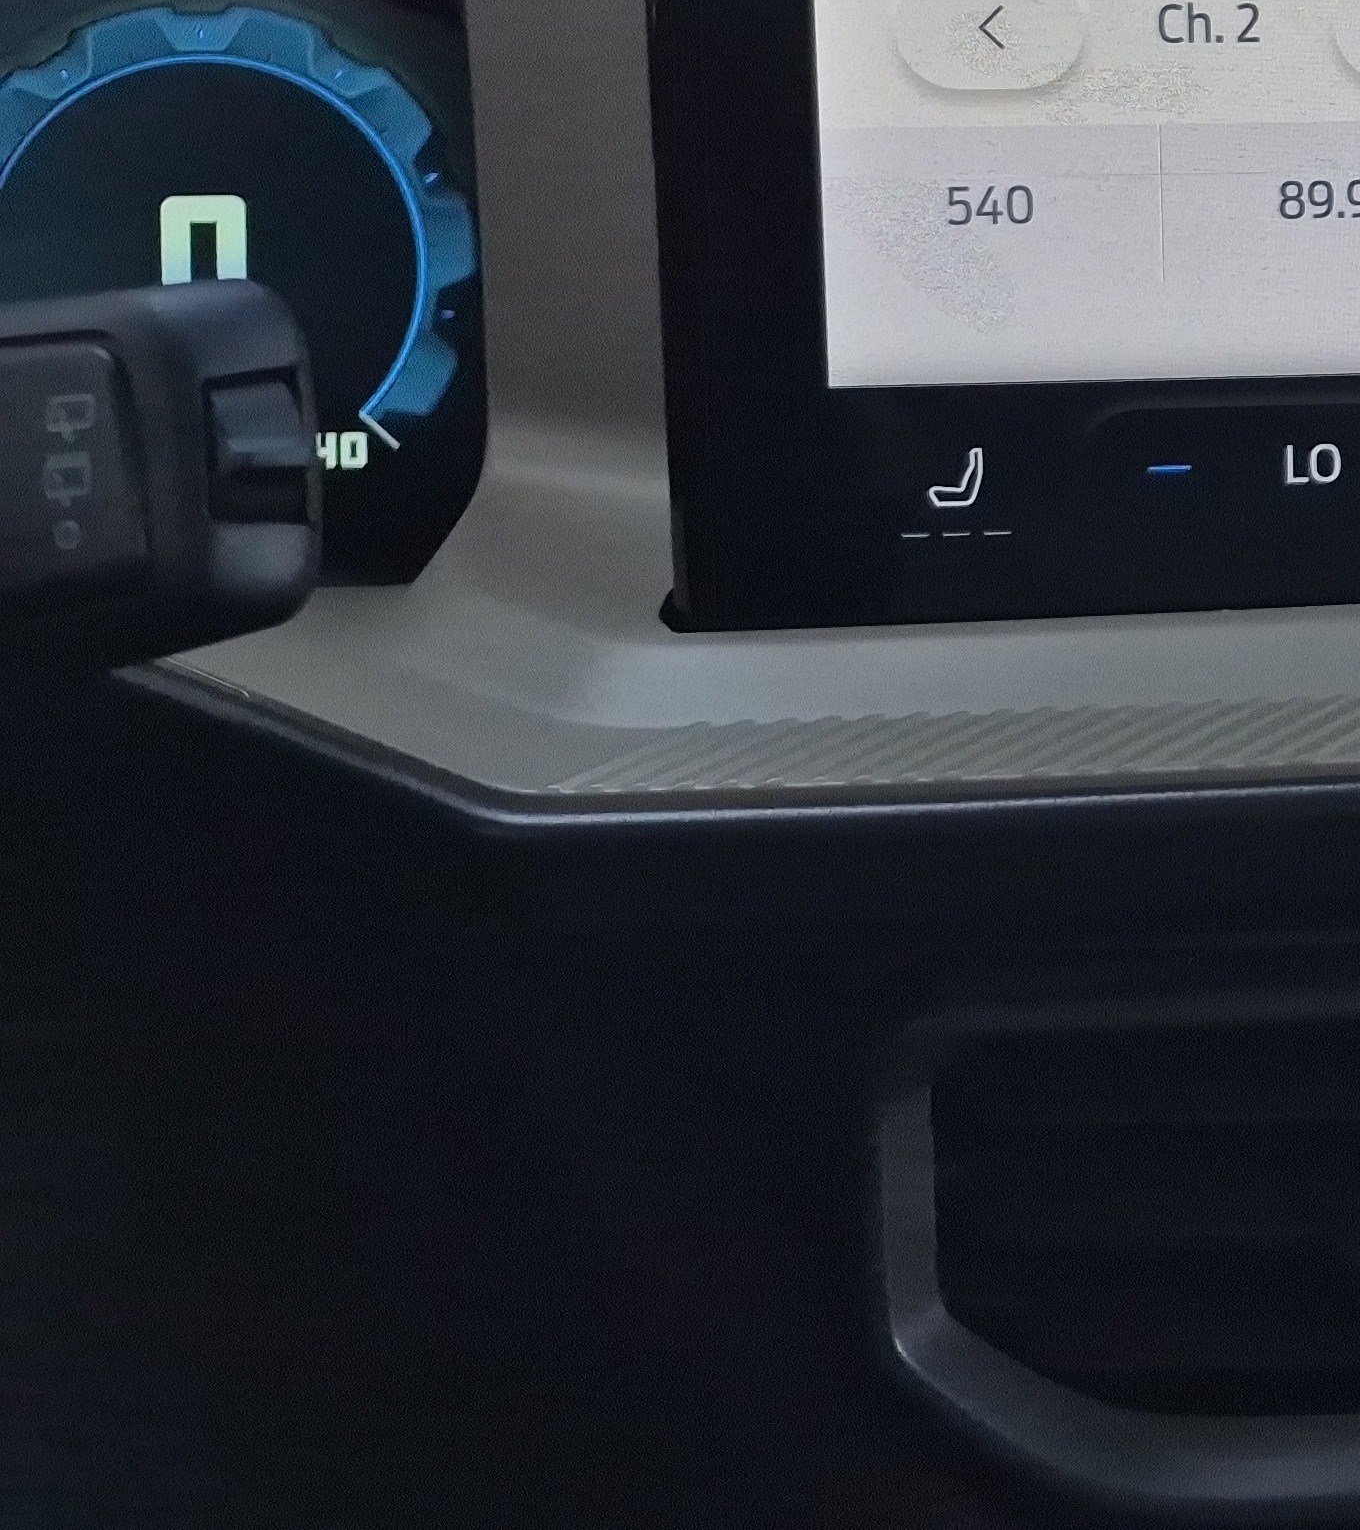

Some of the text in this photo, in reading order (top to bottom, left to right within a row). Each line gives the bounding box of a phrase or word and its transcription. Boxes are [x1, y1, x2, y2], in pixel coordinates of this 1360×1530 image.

[1157, 2, 1262, 44] Ch. 2
[946, 185, 1035, 226] 540
[1284, 443, 1342, 485] LO
